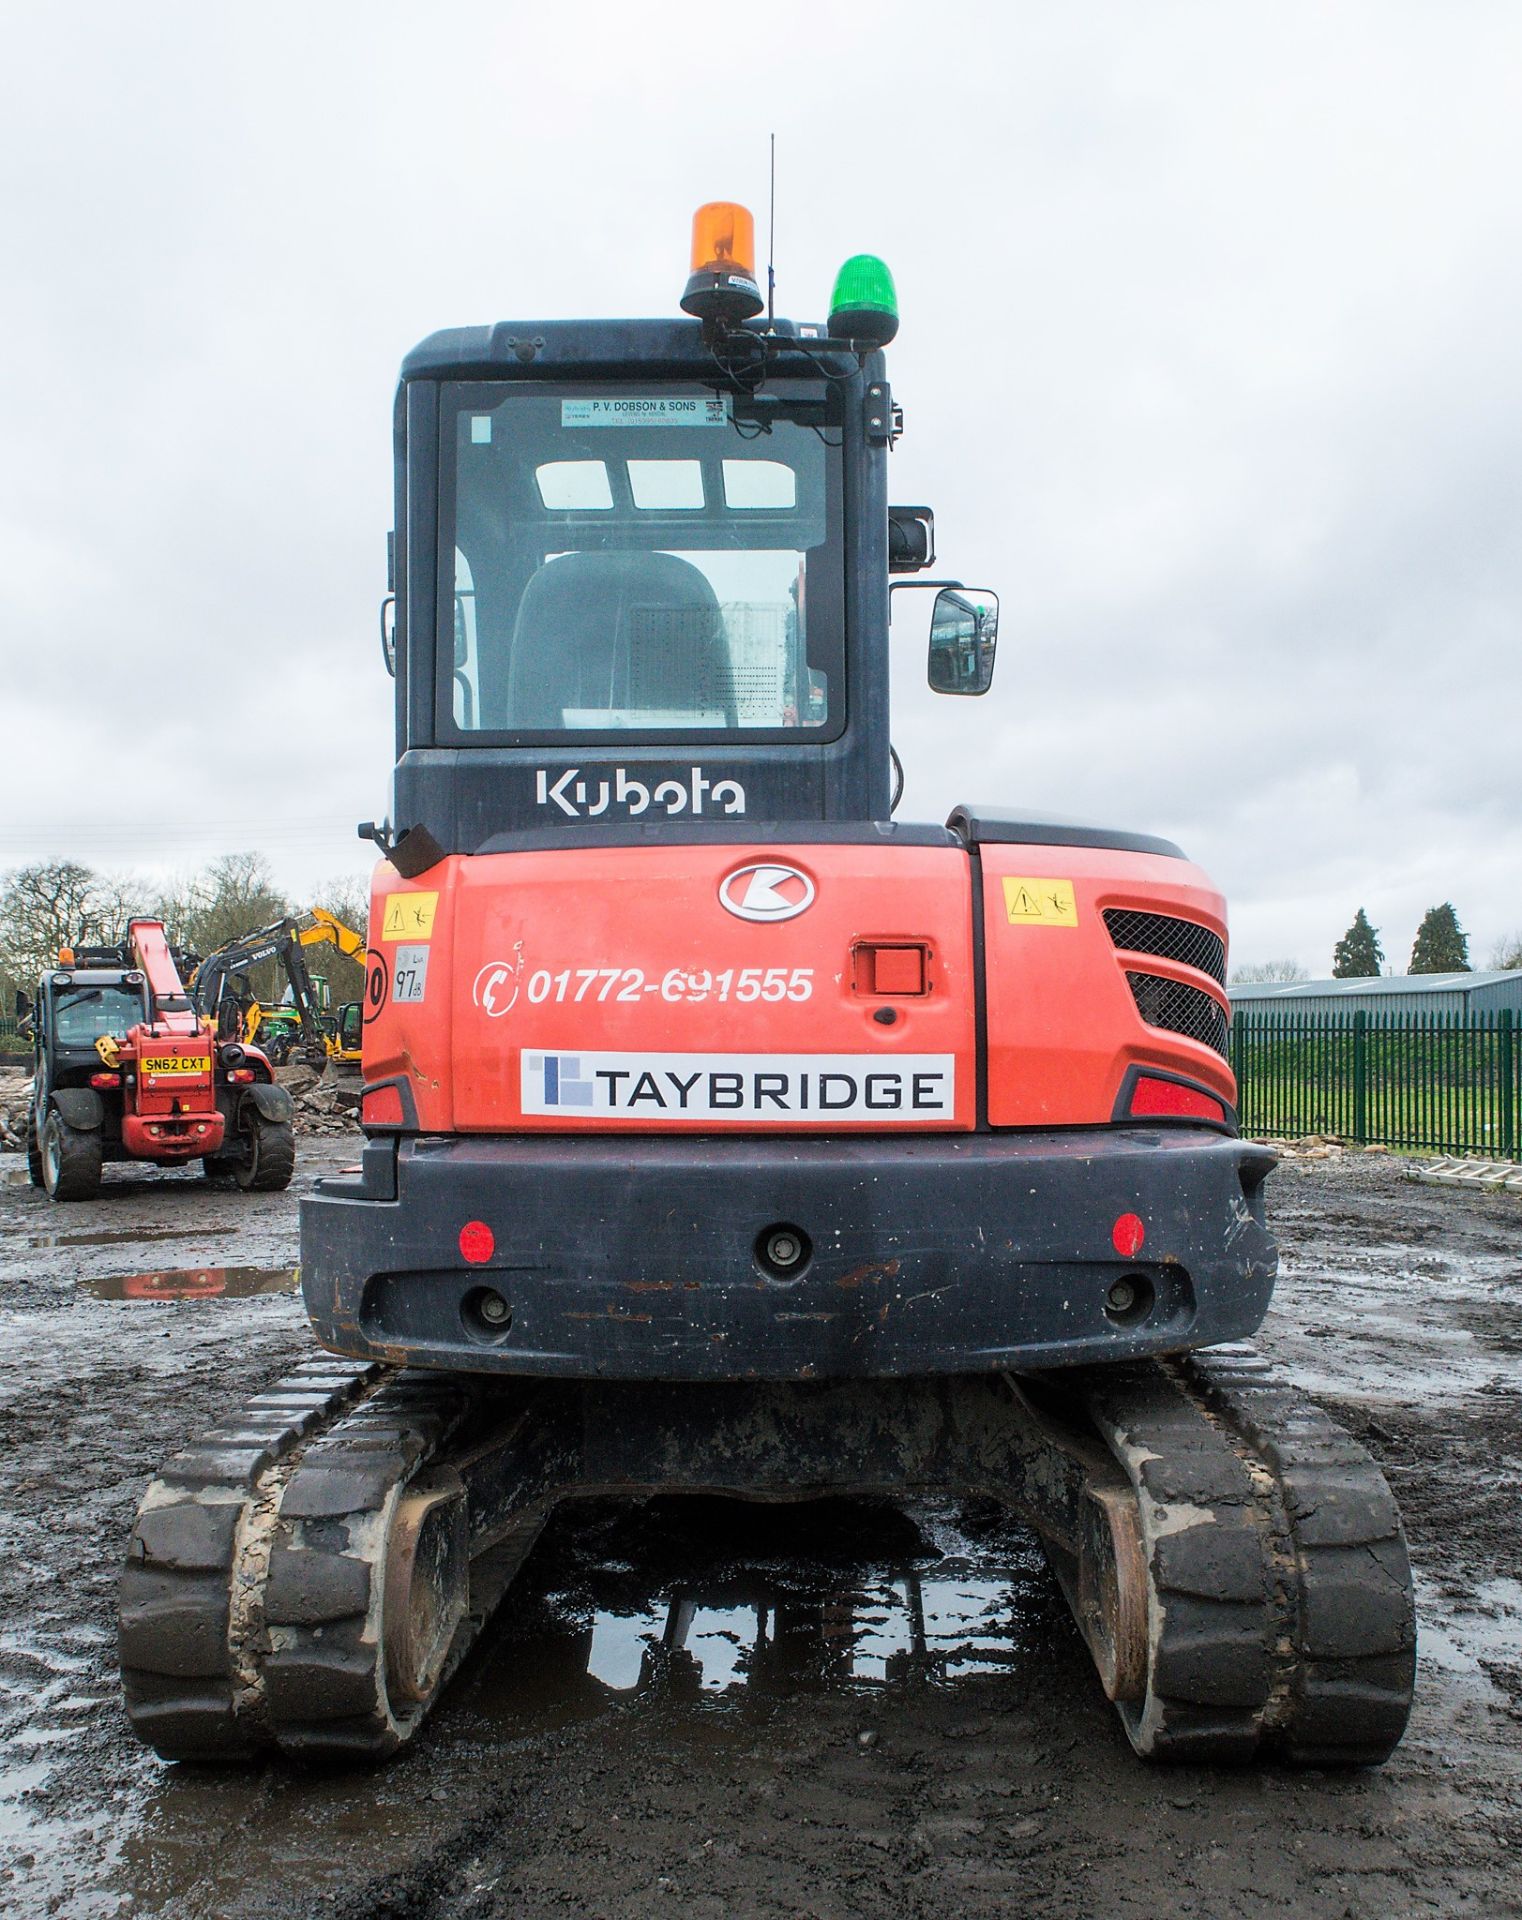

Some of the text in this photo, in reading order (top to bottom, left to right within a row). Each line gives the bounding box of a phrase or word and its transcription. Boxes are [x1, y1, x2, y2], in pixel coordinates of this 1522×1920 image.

[593, 402, 601, 411] P.
[604, 402, 611, 411] V.
[614, 402, 657, 411] DOBSON
[659, 402, 666, 411] &
[669, 402, 696, 411] SONS
[536, 767, 746, 816] Kubota
[251, 946, 277, 960] VOLVO
[527, 968, 814, 1003] 01772-691555
[145, 1058, 205, 1070] SN62 CXT
[595, 1070, 944, 1110] TAYBRIDGE
